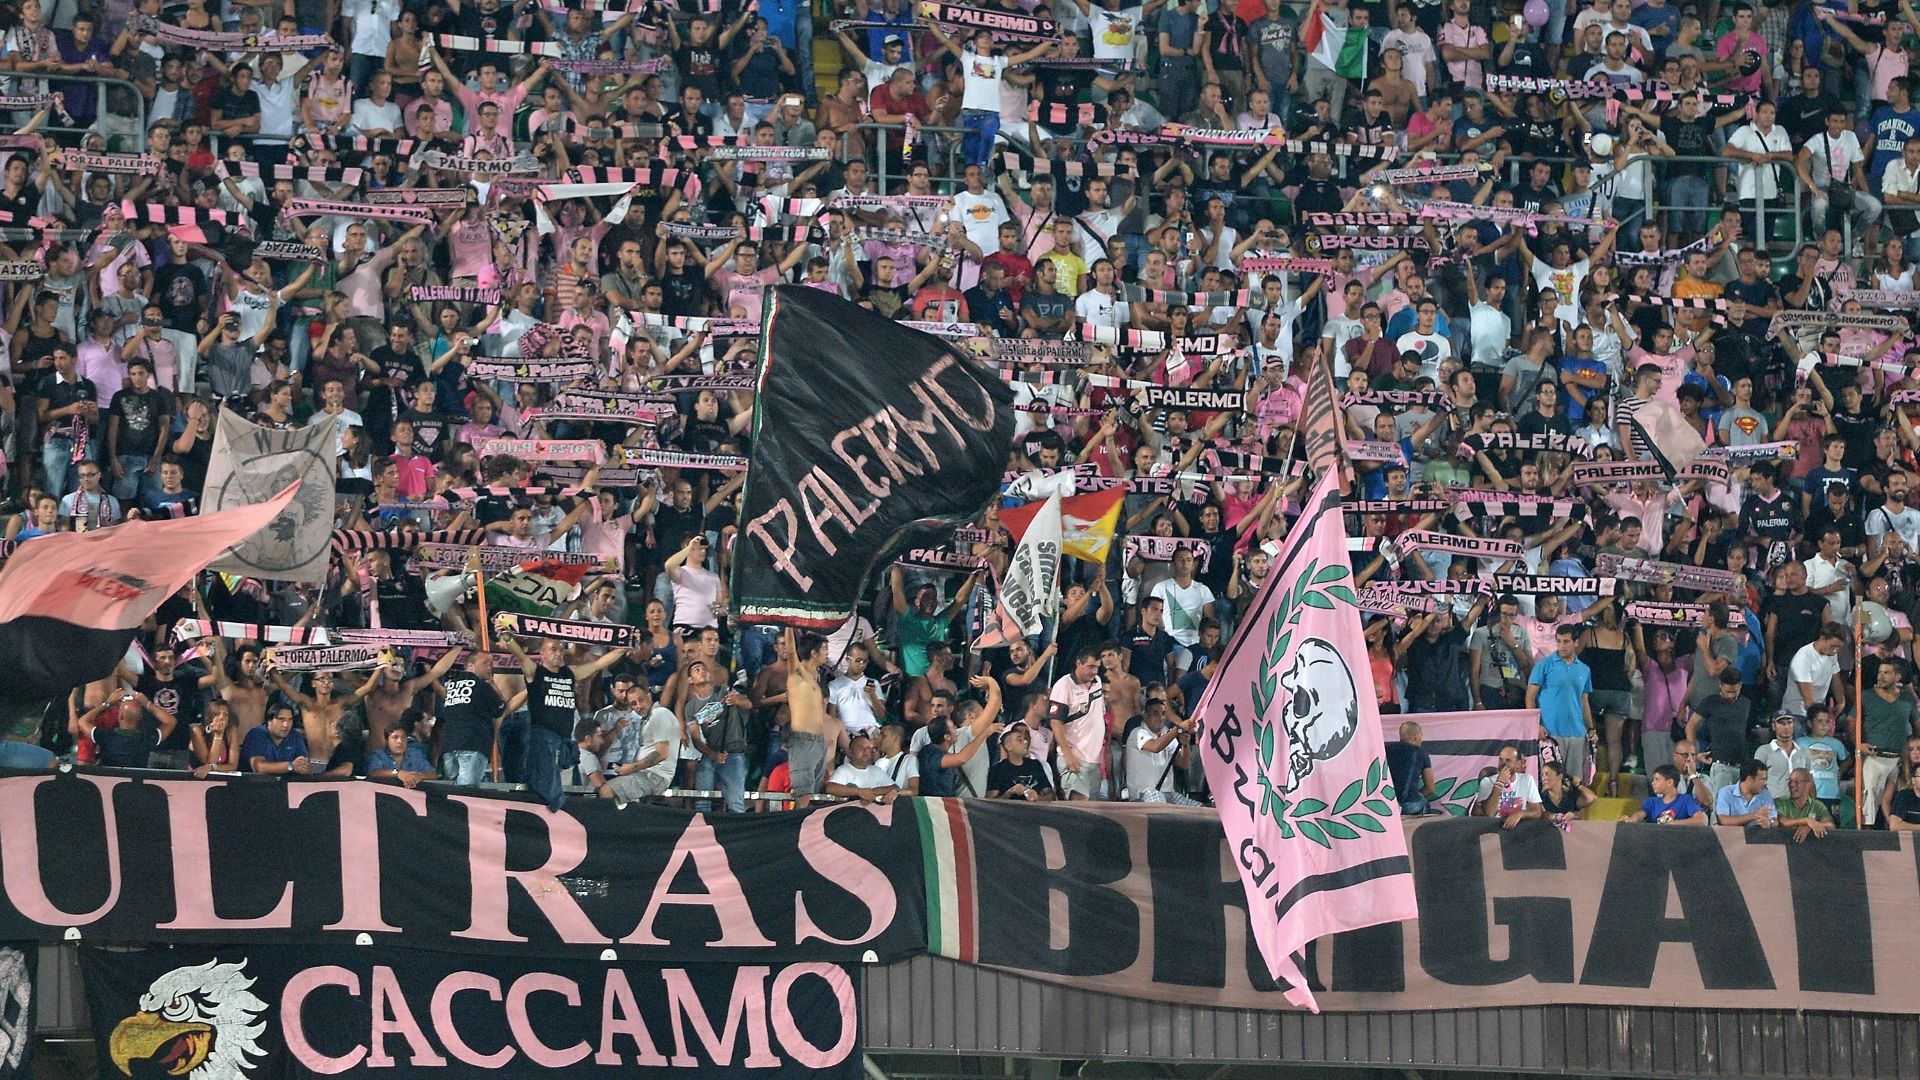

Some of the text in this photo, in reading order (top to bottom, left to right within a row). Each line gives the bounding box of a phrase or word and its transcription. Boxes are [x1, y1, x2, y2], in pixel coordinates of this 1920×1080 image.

[947, 7, 1038, 32] PALERMO
[1877, 118, 1915, 138] FRANKLIN
[1876, 139, 1904, 151] MARSHAL
[64, 155, 161, 168] FORZA PALERMO
[440, 158, 512, 173] PALERMO
[1321, 234, 1431, 250] BRIGATE
[412, 286, 500, 305] PALERMO TI AMO
[1783, 313, 1894, 326] BRIGATE ROSANERO
[1047, 346, 1084, 357] PALERMO
[467, 362, 595, 377] Forza Palermo
[1150, 389, 1241, 408] PALERMO
[583, 407, 635, 416] PALERMO
[642, 449, 690, 464] CATANIA
[746, 354, 996, 593] PALERMO
[1576, 464, 1663, 480] PALERMO
[1692, 464, 1728, 480] AMO
[1074, 476, 1172, 493] RIGATE
[1757, 518, 1789, 528] PALERMO
[1402, 534, 1525, 554] PALERMO TI AM
[436, 550, 468, 563] FORZ
[910, 549, 985, 568] PALERM
[1372, 580, 1493, 596] BRIGATE
[1498, 576, 1597, 593] PALERMO
[1002, 573, 1037, 630] Wear
[1380, 592, 1421, 607] PALERMO
[1626, 603, 1673, 620] Forza
[525, 618, 614, 643] PALERMO
[285, 649, 367, 663] FORZA PALERMO
[0, 774, 898, 947] ULTRAS
[280, 962, 858, 1075] CACCAMO
